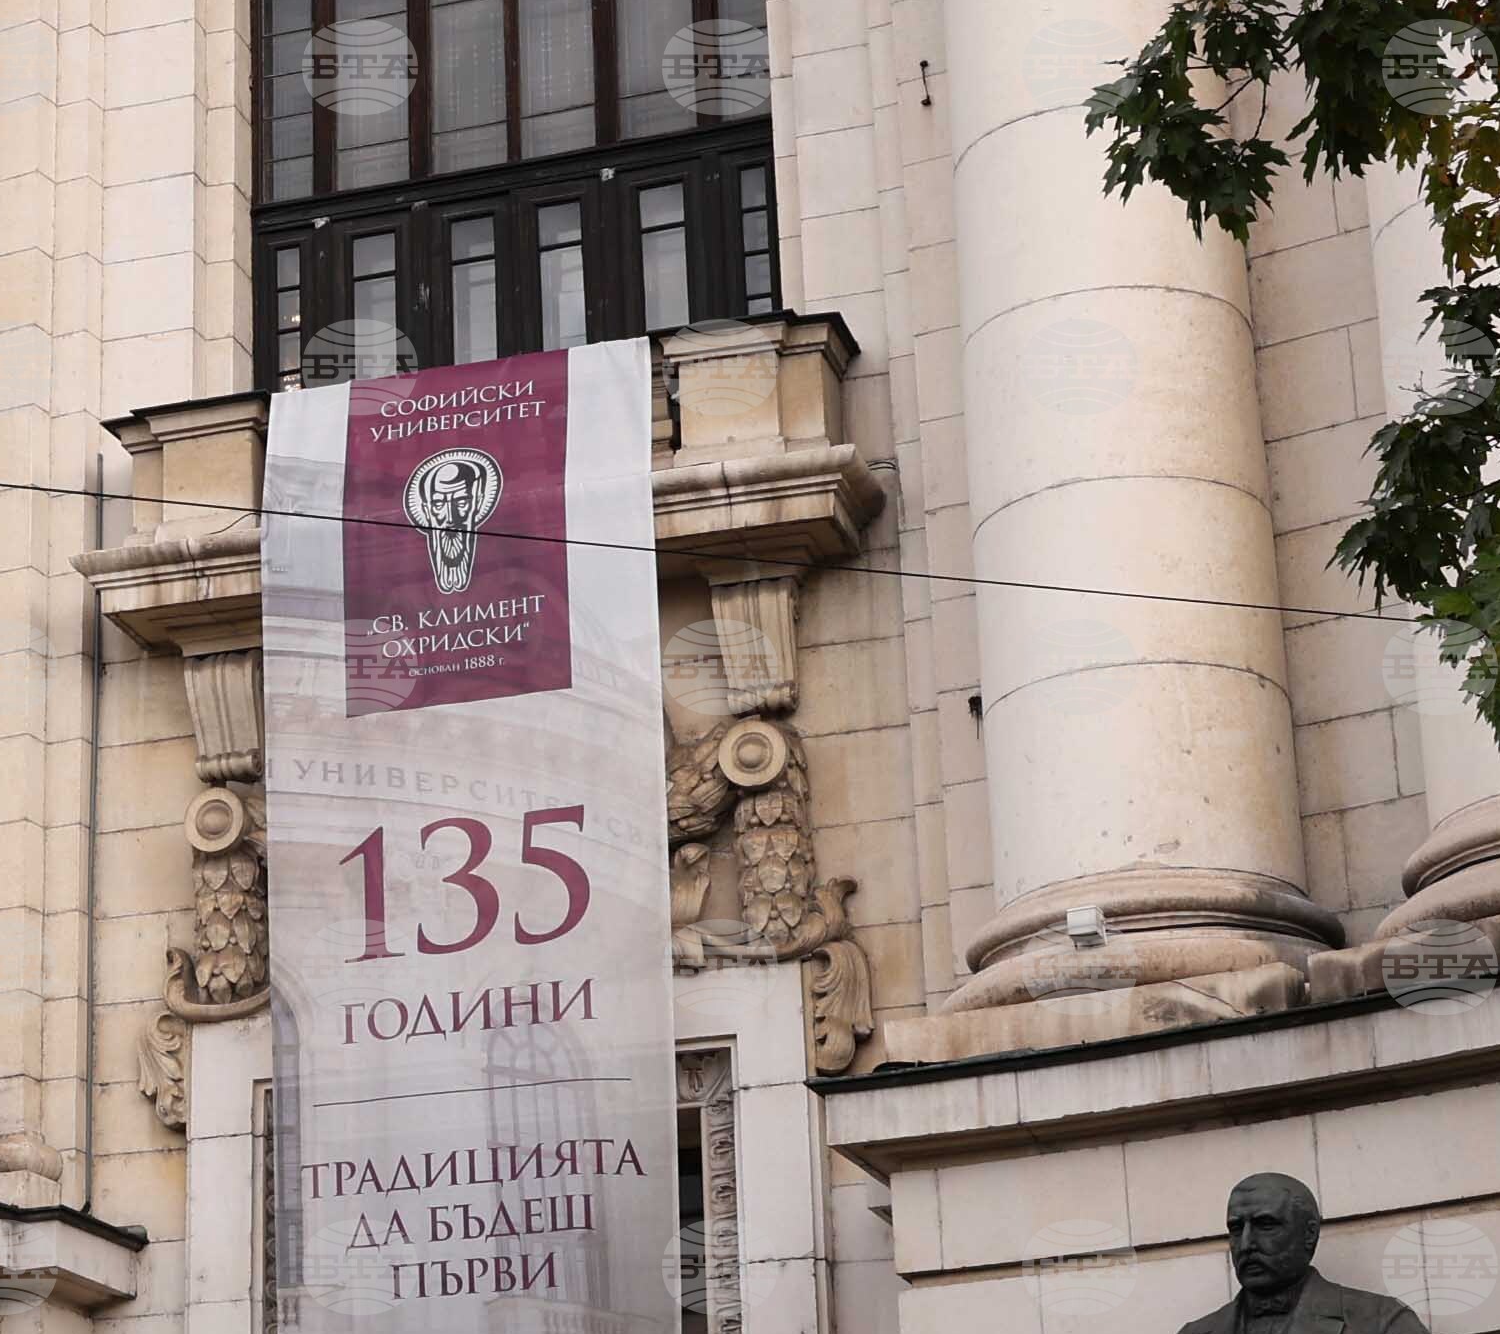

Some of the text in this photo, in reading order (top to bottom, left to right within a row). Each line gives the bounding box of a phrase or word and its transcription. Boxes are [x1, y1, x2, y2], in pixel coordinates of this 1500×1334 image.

[370, 400, 547, 443] УНИВЕРСИТЕТ
[380, 379, 535, 418] СОФИЙСКИ
[418, 594, 546, 629] КЛИМЕНТ
[463, 654, 496, 671] 1888
[339, 804, 592, 964] 135
[340, 978, 598, 1046] ГОДИНИ
[301, 1138, 648, 1199] ТРАДИЦИЯТА
[345, 1193, 596, 1255] ДА БЪДЕШ
[391, 1252, 560, 1301] ПЪРВИ
